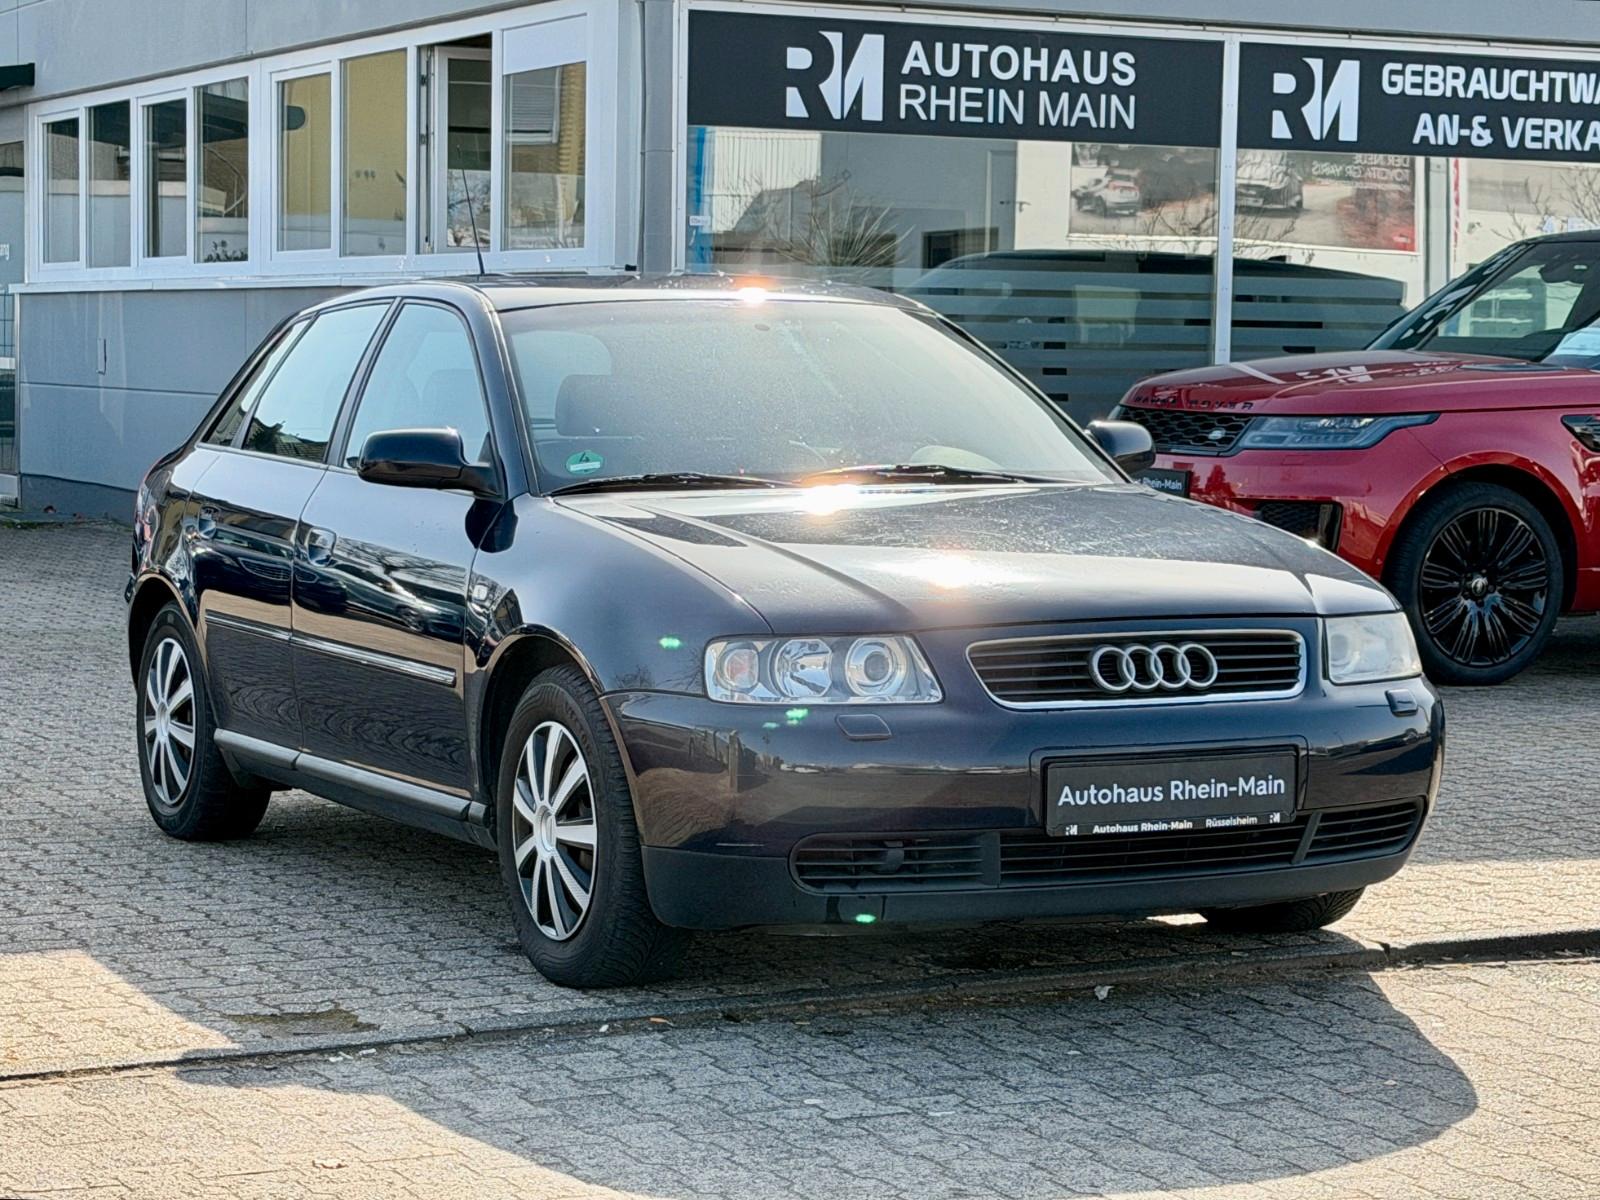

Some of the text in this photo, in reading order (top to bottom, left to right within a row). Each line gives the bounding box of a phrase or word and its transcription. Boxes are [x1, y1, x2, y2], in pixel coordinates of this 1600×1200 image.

[901, 40, 1138, 86] AUTOHAUS
[1382, 62, 1600, 104] GEBRAUCHTW
[899, 83, 1137, 130] RHEIN MAIN
[1057, 774, 1286, 807] Autohaus Rhein-Main
[1092, 823, 1139, 835] Autohaus
[1140, 818, 1193, 833] Rhein-Main
[1205, 815, 1258, 829] Rüsselsheim
